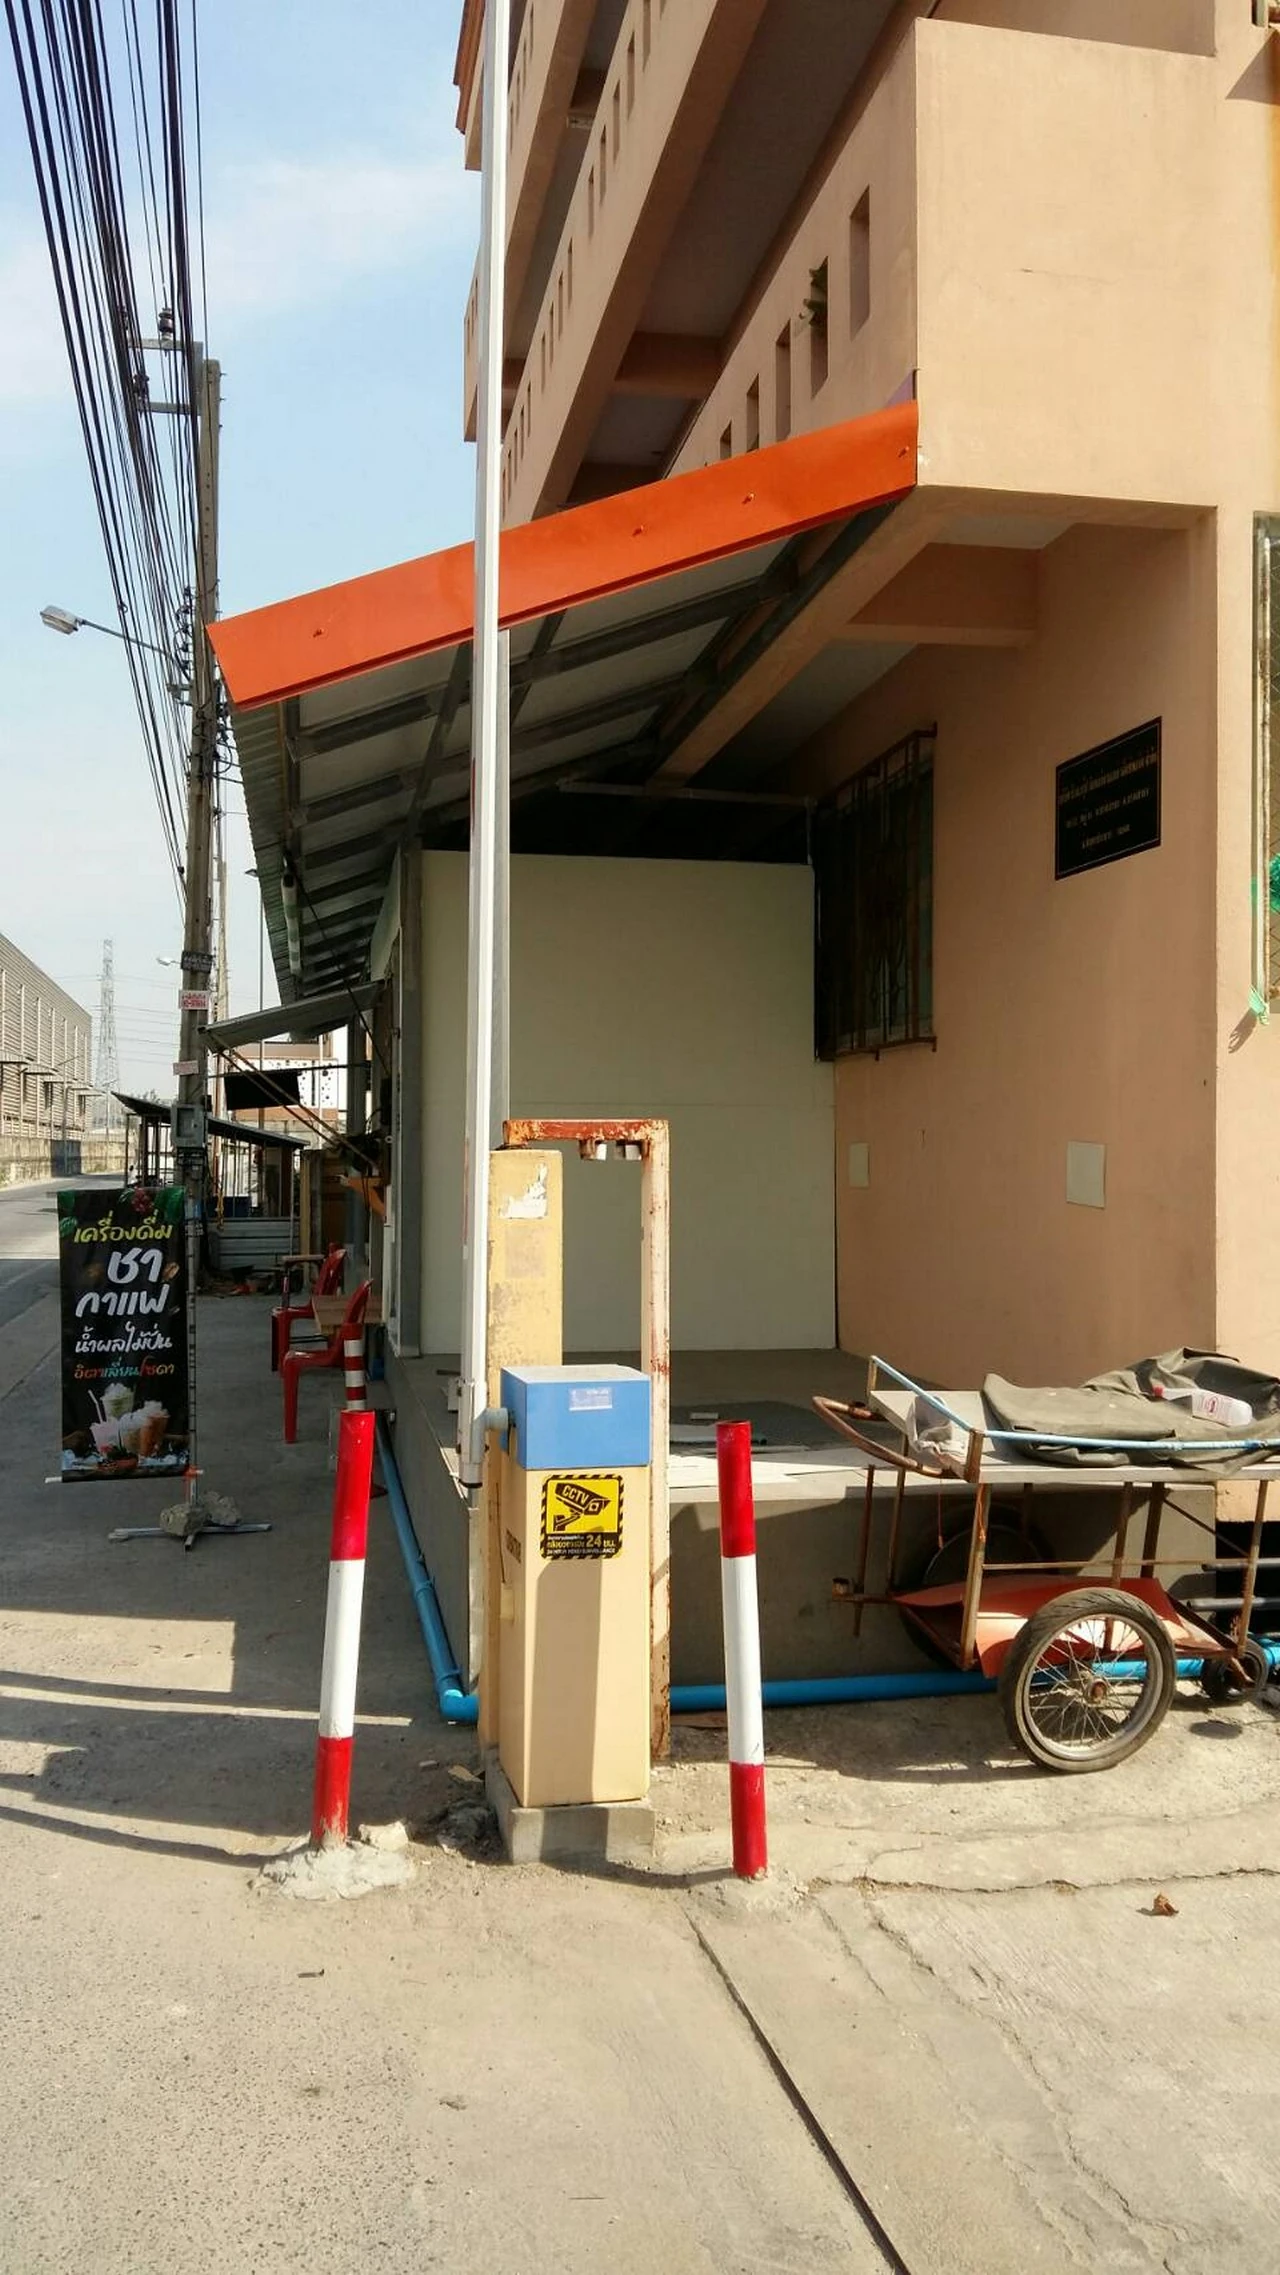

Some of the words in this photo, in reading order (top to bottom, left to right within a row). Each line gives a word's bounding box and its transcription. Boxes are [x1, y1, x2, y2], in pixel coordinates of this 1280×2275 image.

[74, 1210, 173, 1243] เครื่องดื่ม
[107, 1247, 164, 1284] ชา
[75, 1283, 170, 1318] กาแฟ
[75, 1320, 173, 1354] น้ำผลไม้ปั่น
[562, 1485, 589, 1505] CCTV
[586, 1534, 602, 1548] 24
